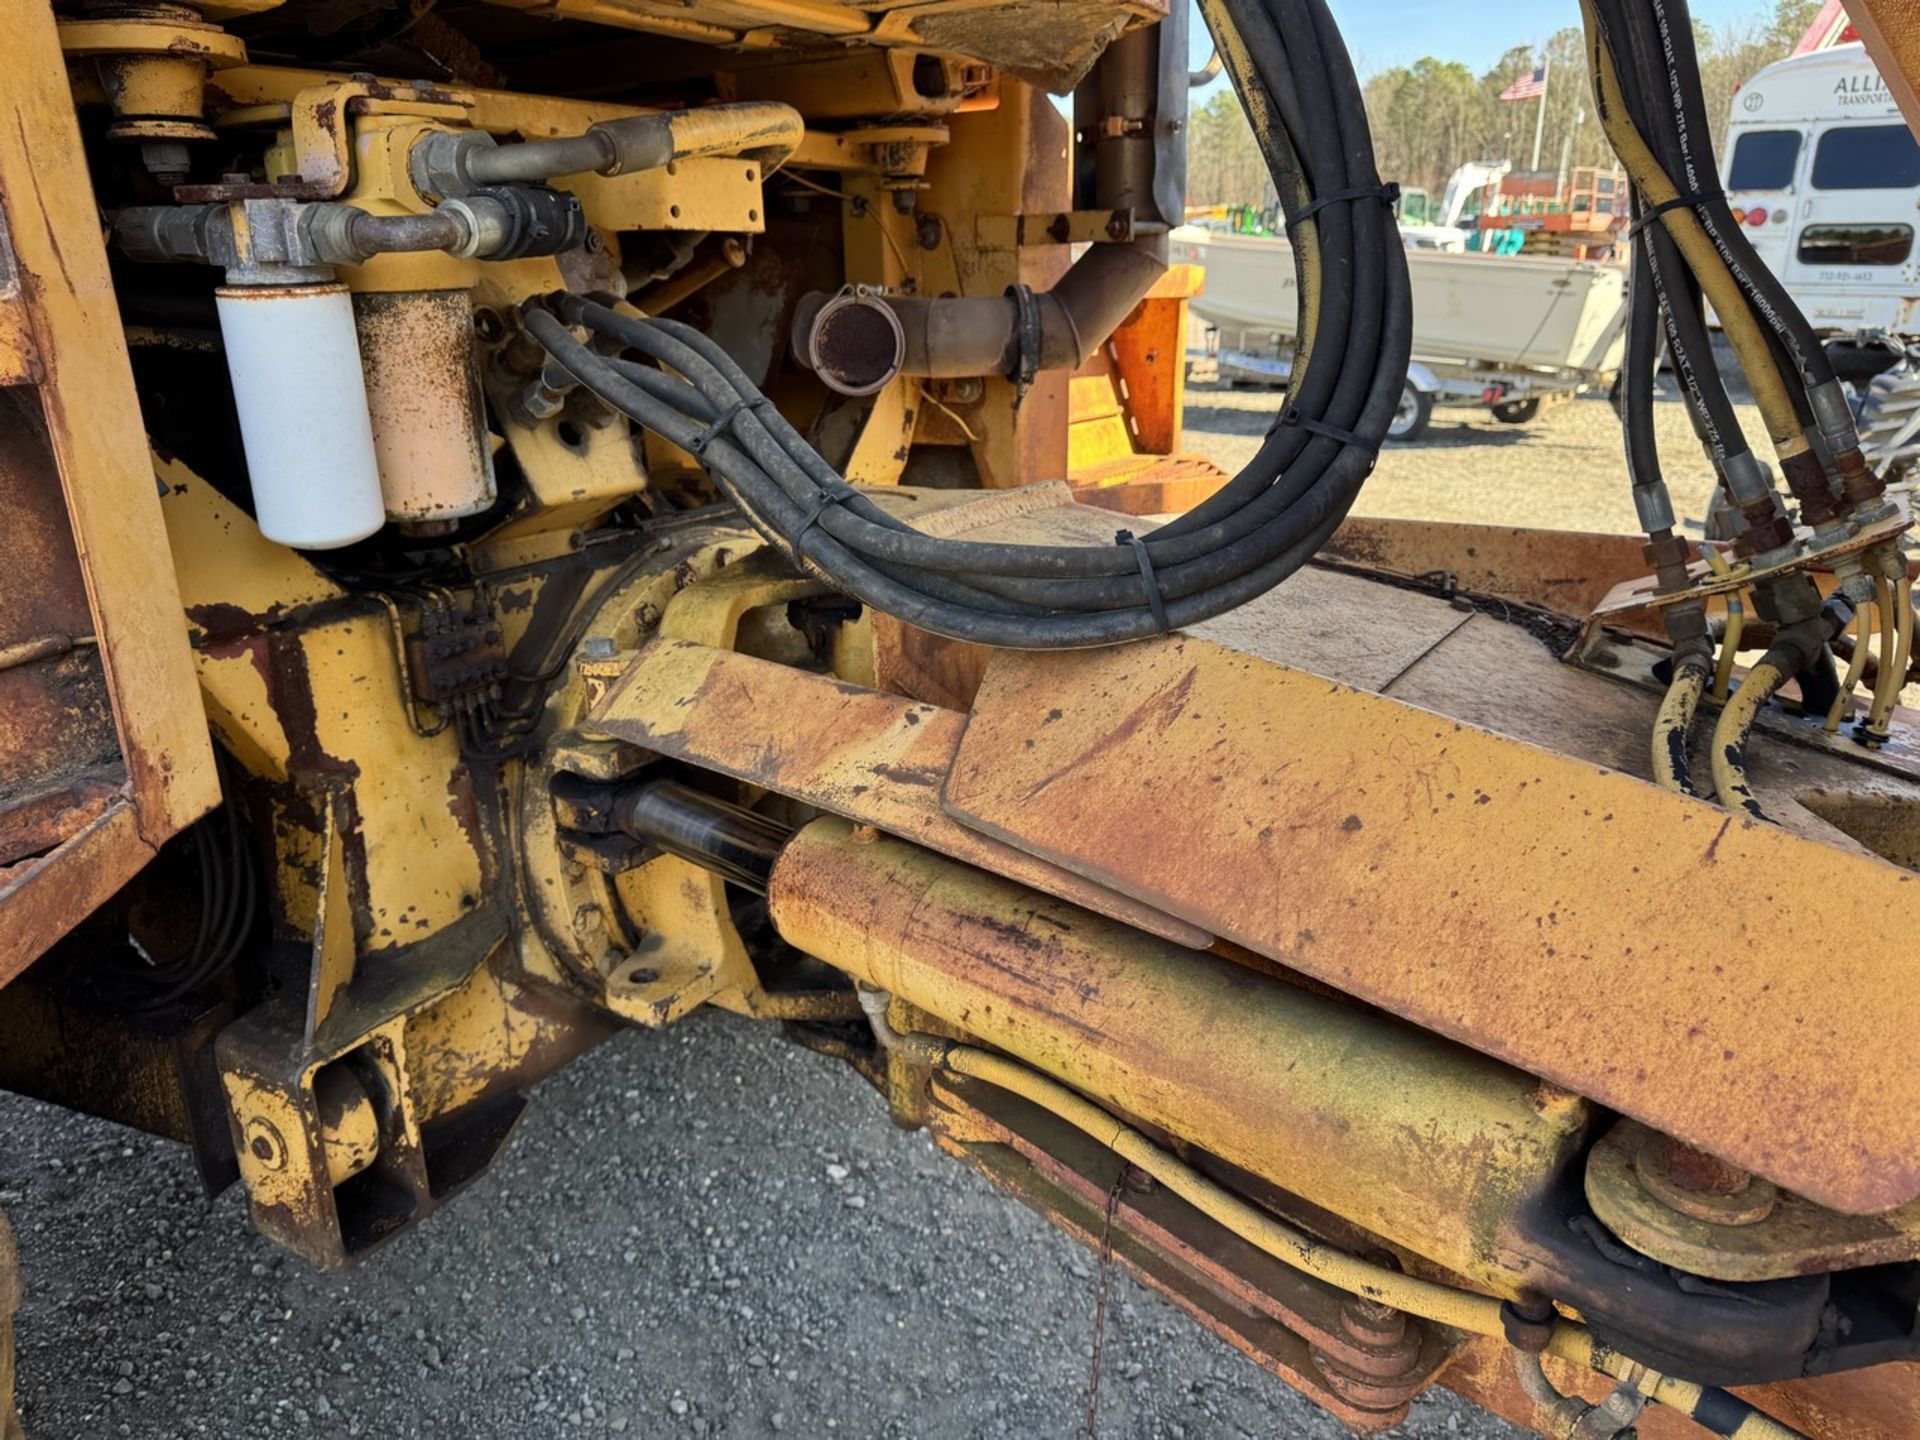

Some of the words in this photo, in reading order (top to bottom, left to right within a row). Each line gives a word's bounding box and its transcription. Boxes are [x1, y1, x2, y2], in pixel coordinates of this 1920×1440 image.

[1833, 75, 1886, 94] ALLI
[1838, 93, 1892, 106] TRANSPORT
[1680, 132, 1689, 153] Bar
[1731, 264, 1746, 283] Bar
[1750, 289, 1786, 333] 16000psi
[1672, 338, 1689, 369] R2AT
[1696, 398, 1710, 419] WP
